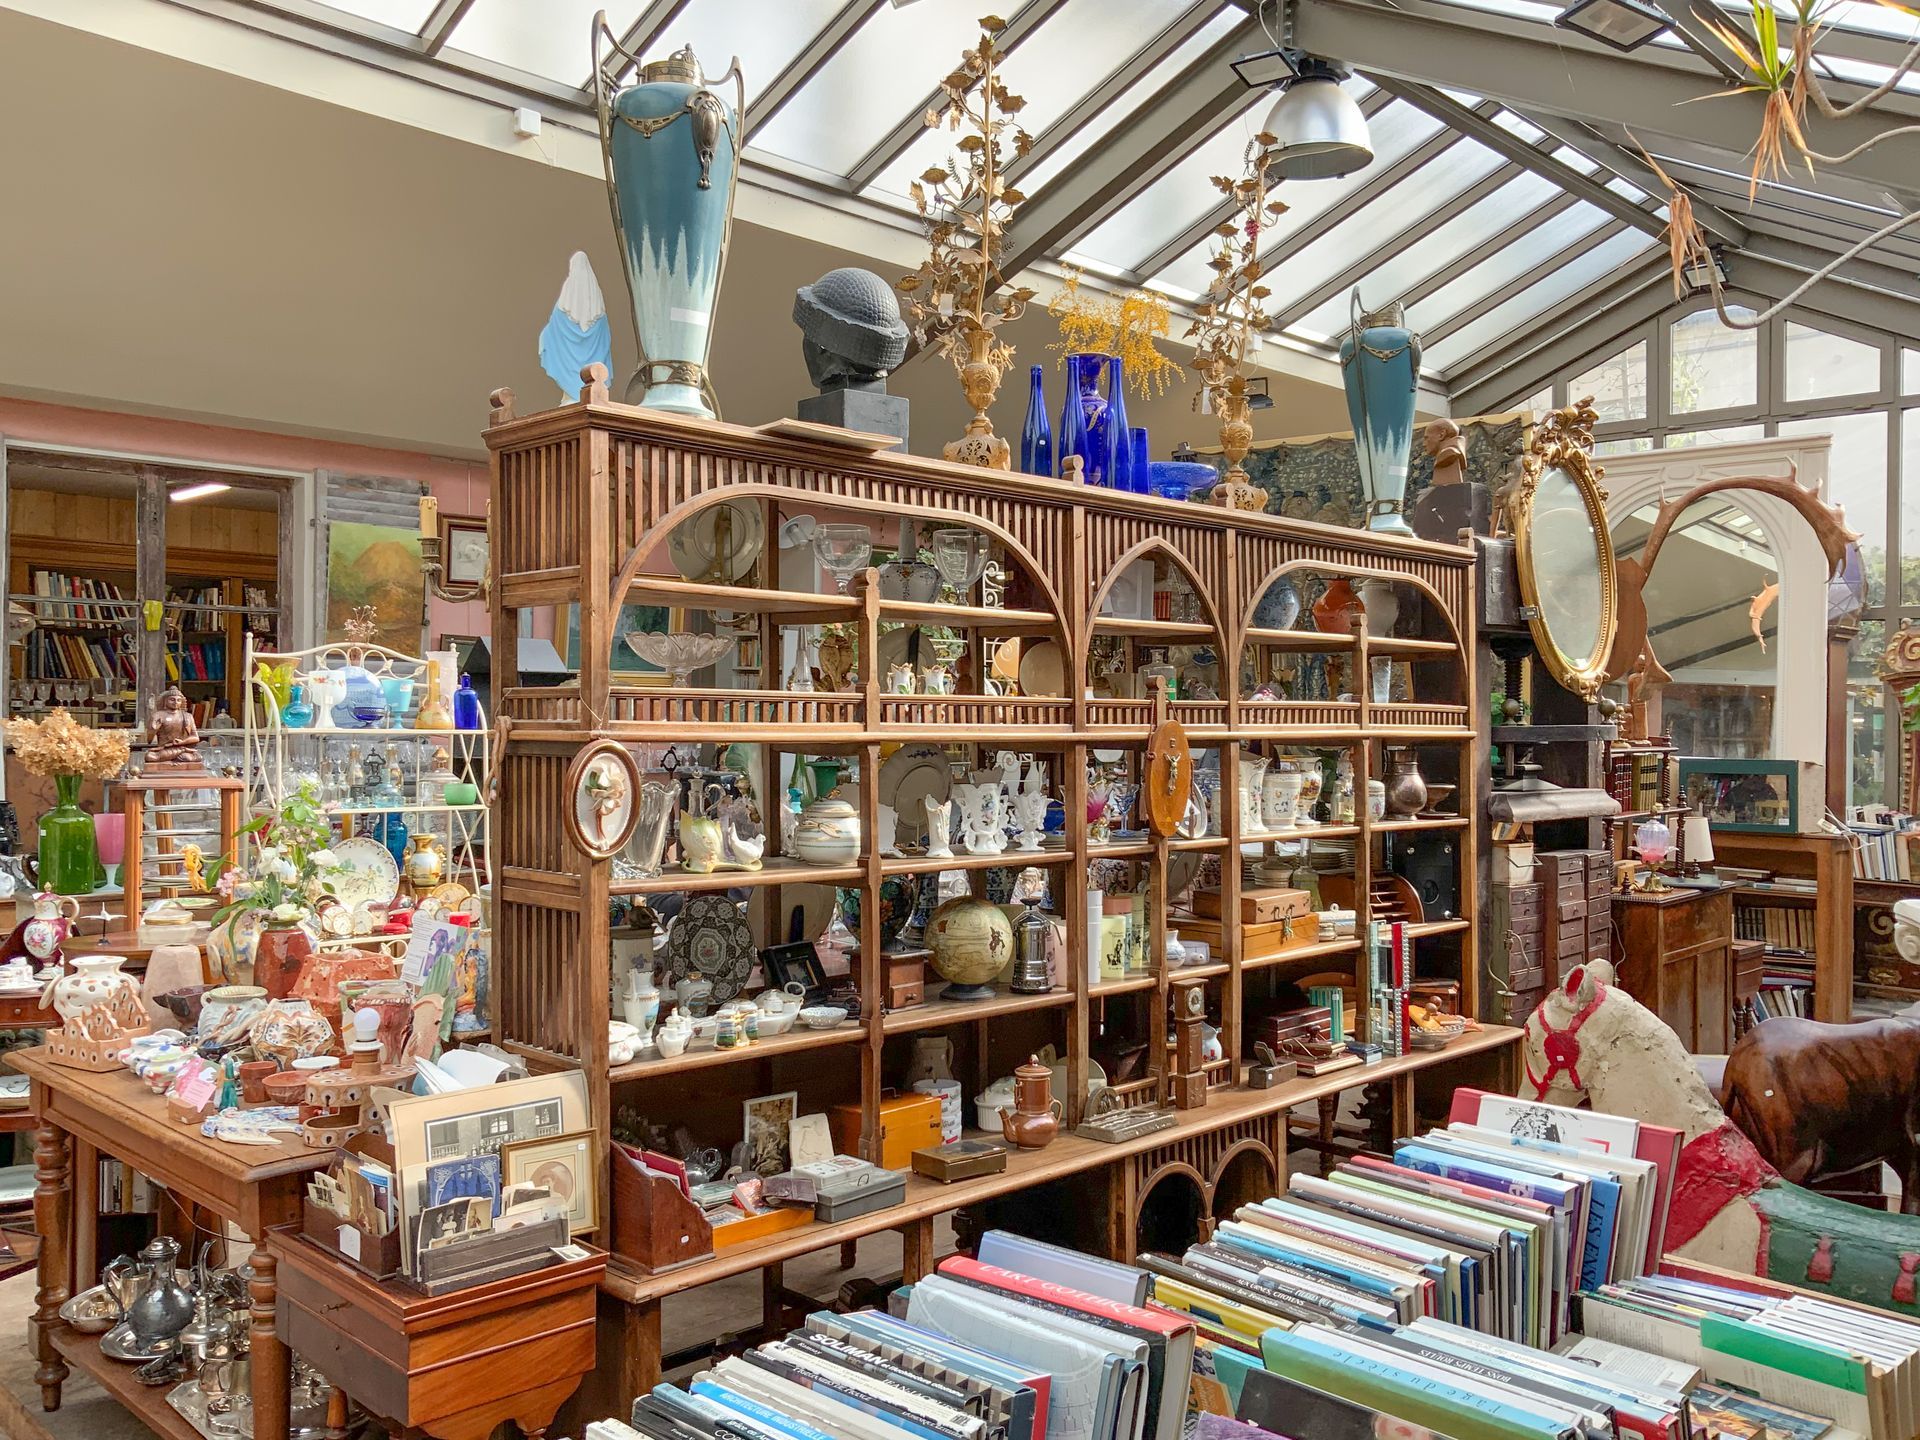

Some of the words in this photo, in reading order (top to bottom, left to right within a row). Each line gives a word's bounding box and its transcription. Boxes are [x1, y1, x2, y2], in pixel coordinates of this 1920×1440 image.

[1587, 1199, 1605, 1238] LES
[972, 1264, 1037, 1282] L'ART
[1039, 1278, 1159, 1321] GOTHIQUE
[808, 1330, 887, 1367] SOLIMAN
[1332, 1349, 1401, 1380] siècle
[1453, 1359, 1485, 1375] TEMPS
[1485, 1369, 1512, 1384] BONS
[1410, 1375, 1437, 1393] du
[1446, 1386, 1502, 1414] l'âge
[719, 1392, 778, 1420] ARCHITECTURE
[770, 1414, 827, 1440] INDUSTRIELLE
